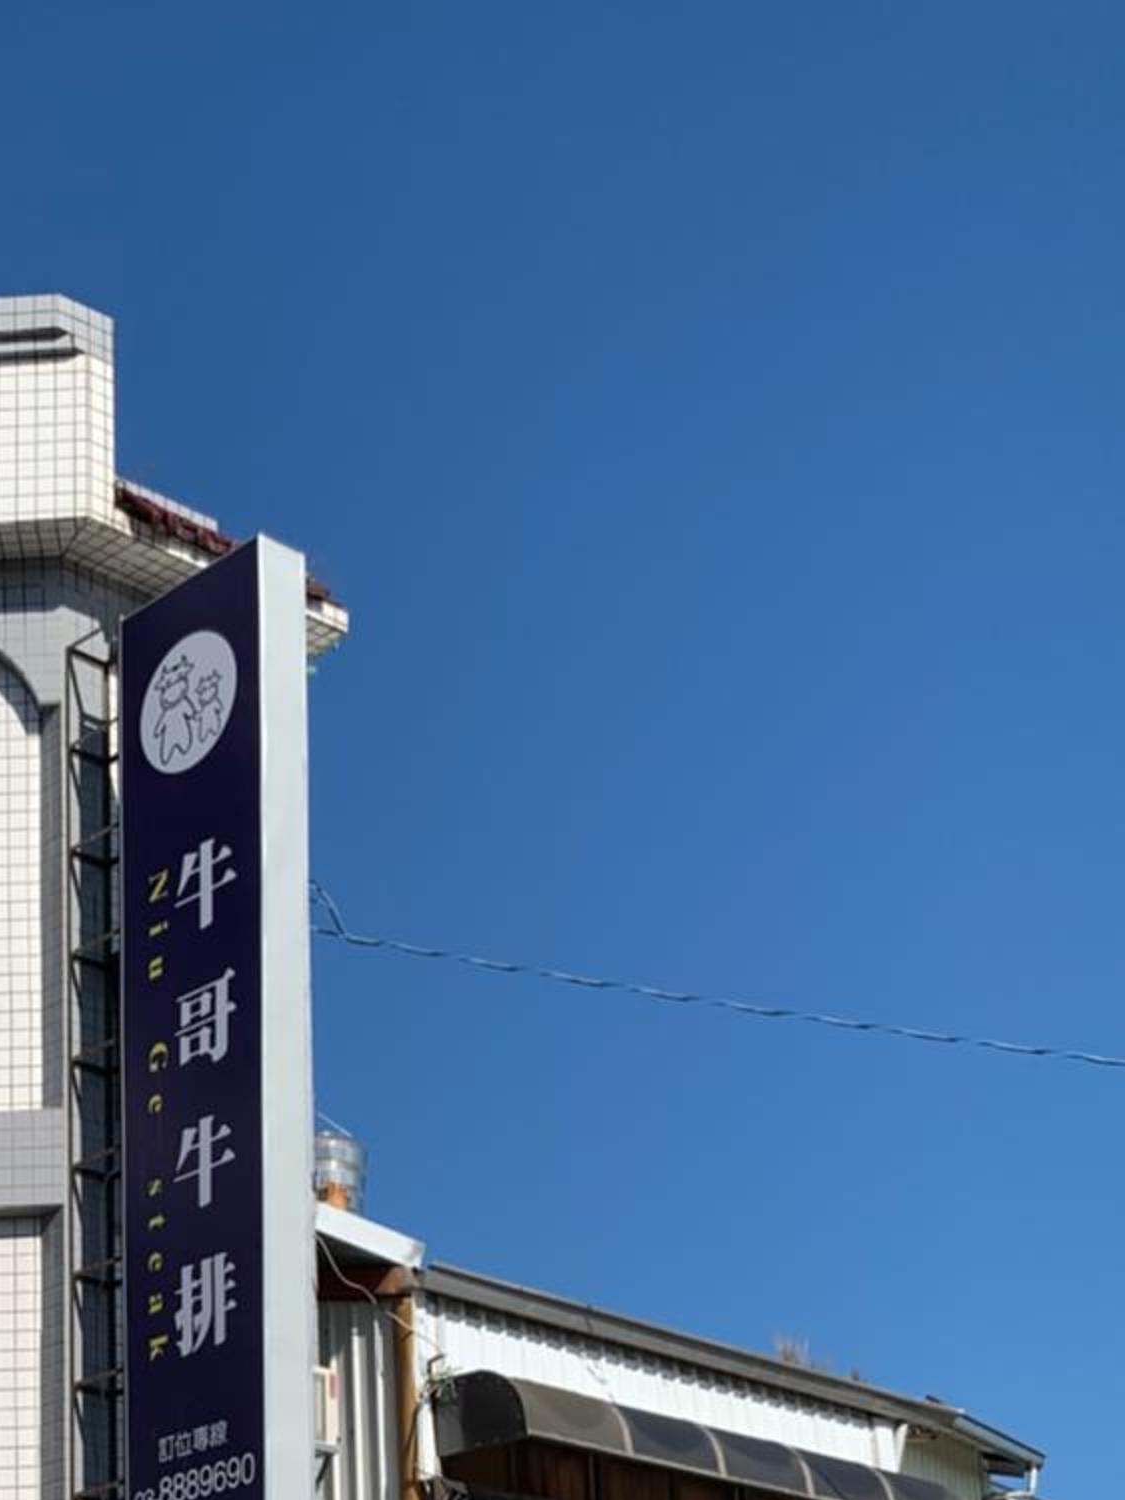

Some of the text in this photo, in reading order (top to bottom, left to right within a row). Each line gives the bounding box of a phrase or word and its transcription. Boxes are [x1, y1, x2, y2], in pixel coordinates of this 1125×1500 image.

[147, 869, 169, 1362] Niu Ge steak
[174, 837, 237, 1358] 牛哥牛排
